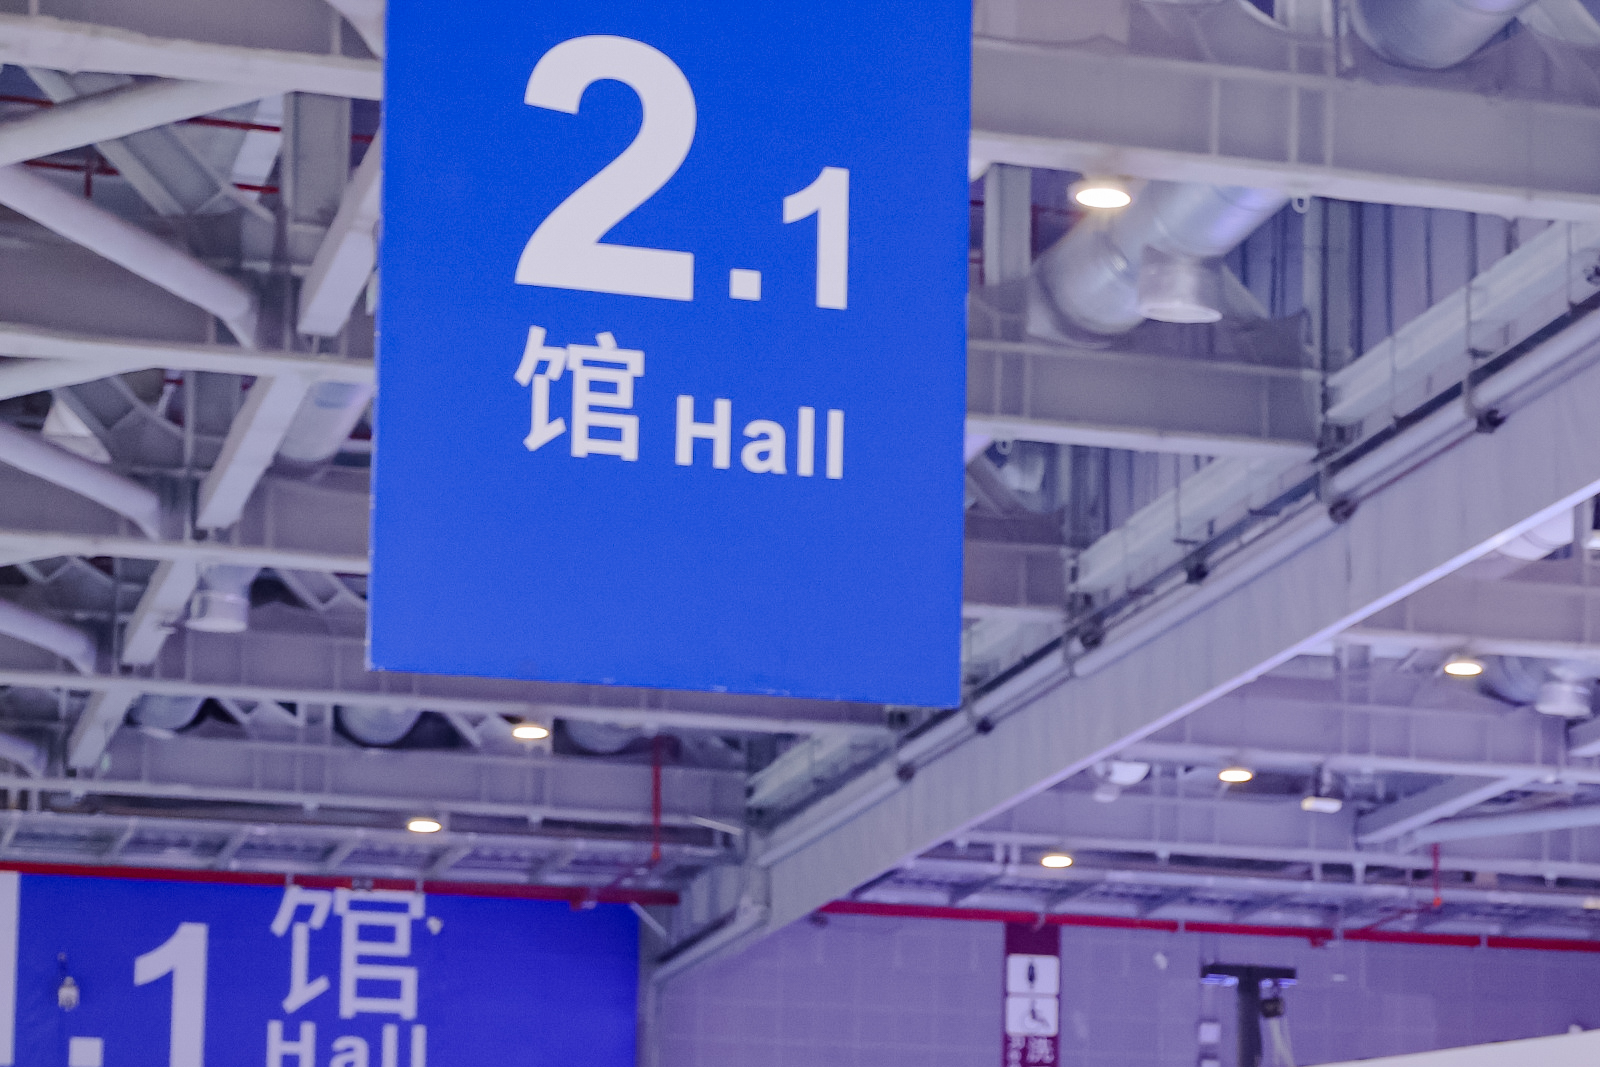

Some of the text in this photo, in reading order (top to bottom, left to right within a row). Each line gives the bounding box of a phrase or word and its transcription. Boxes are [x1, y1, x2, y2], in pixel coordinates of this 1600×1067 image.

[514, 34, 850, 310] 2.1
[513, 325, 845, 479] 馆 Hall
[270, 884, 426, 1020] 馆
